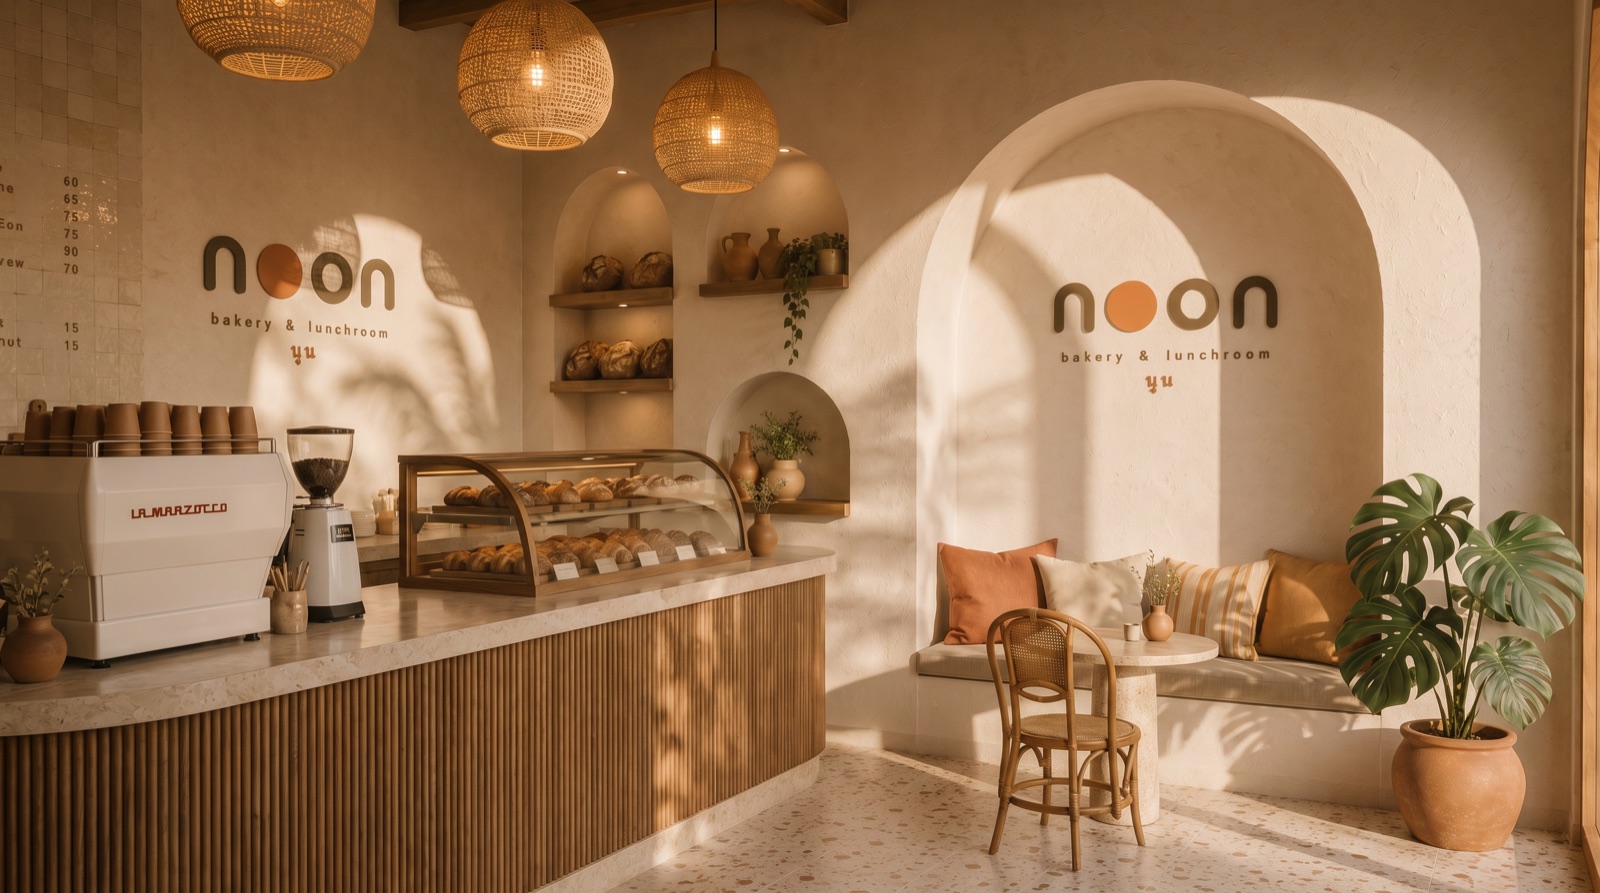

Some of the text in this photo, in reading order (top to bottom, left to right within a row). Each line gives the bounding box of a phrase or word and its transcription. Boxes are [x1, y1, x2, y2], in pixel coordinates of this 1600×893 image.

[63, 175, 79, 187] 60
[63, 193, 79, 205] 65
[63, 210, 79, 222] 75
[63, 228, 79, 240] 75
[63, 245, 79, 257] 90
[63, 263, 79, 275] 70
[64, 322, 79, 334] 15
[210, 311, 389, 339] bakery & lunchroom
[64, 340, 79, 352] 15
[1061, 348, 1270, 365] bakery & lunchroom
[131, 508, 146, 519] LA
